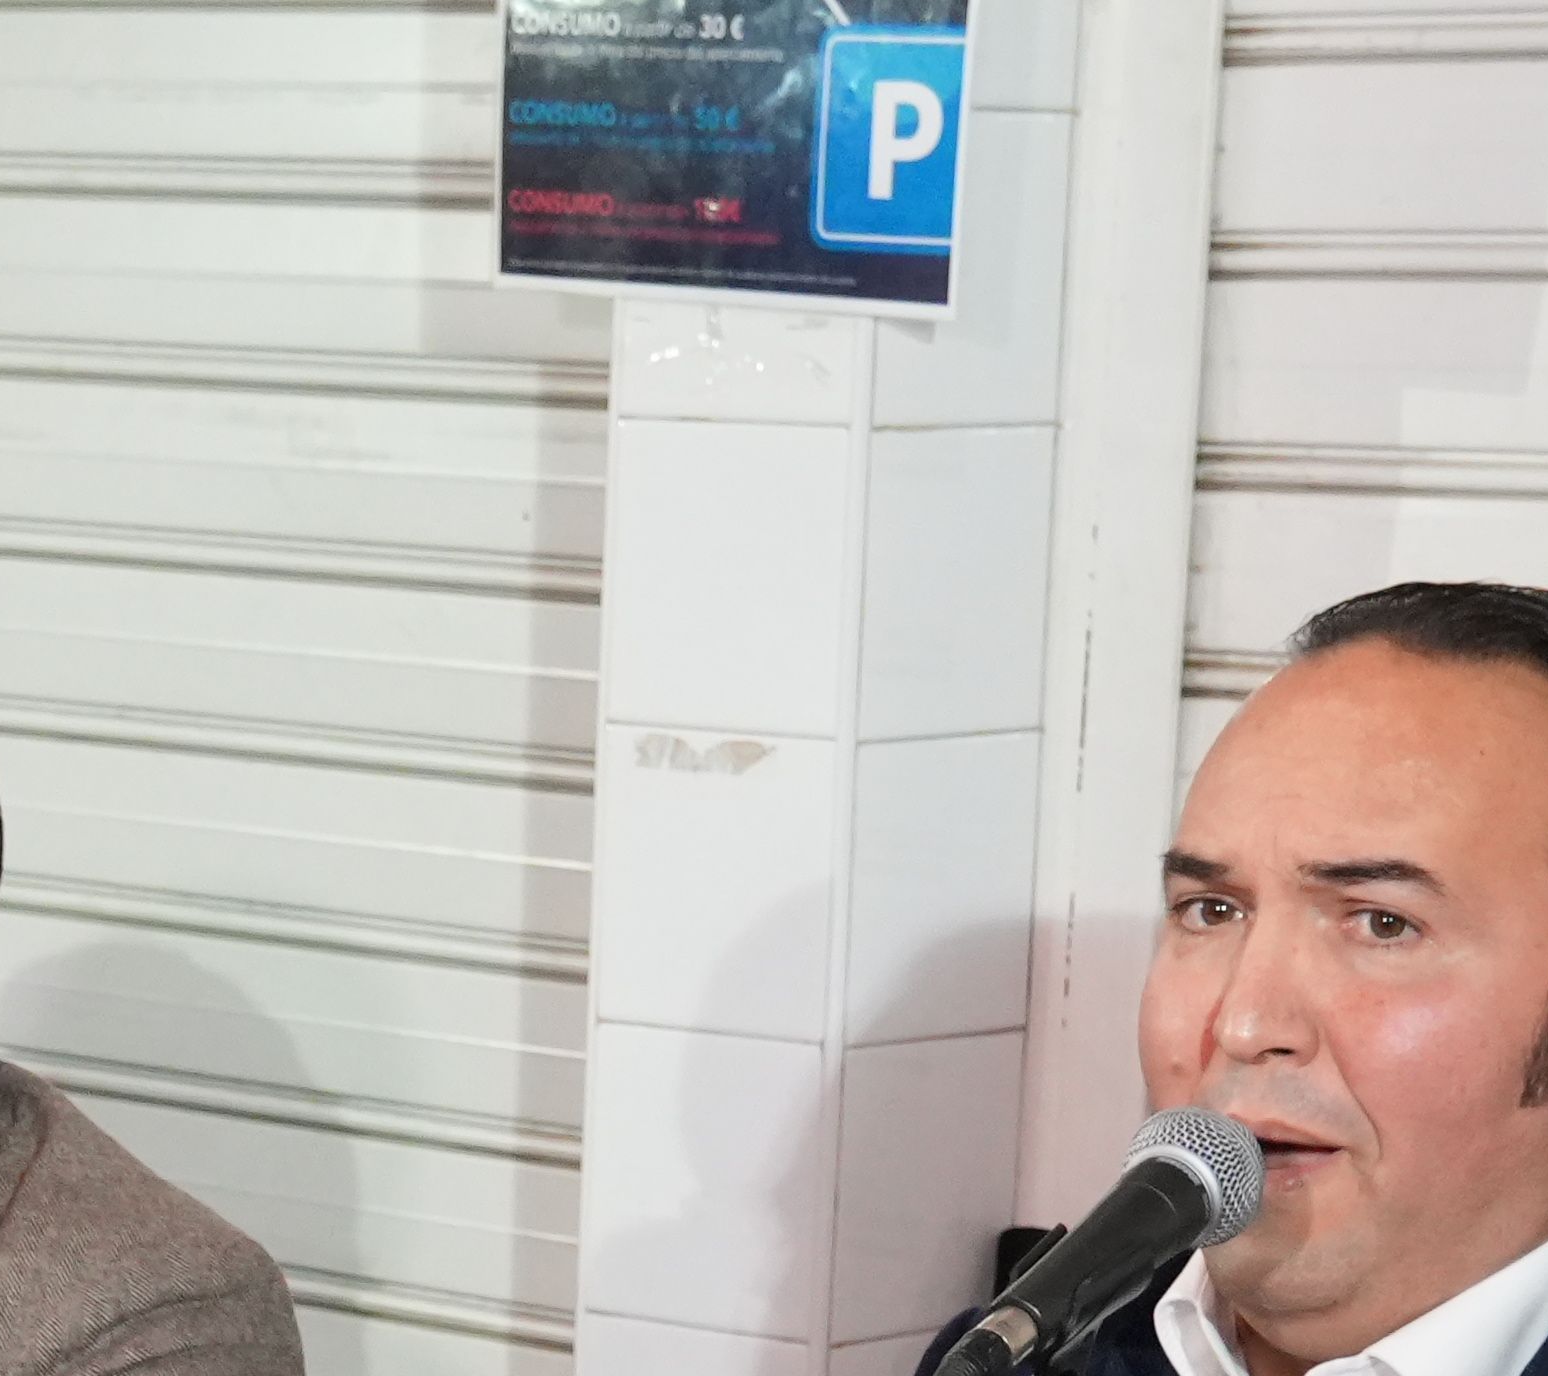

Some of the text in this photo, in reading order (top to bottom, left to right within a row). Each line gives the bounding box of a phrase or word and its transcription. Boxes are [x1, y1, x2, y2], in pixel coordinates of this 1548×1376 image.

[510, 11, 621, 36] CONSUMO
[699, 13, 727, 39] 30
[509, 100, 616, 127] CONSUMO
[867, 79, 944, 201] P
[507, 189, 615, 216] CONSUMO
